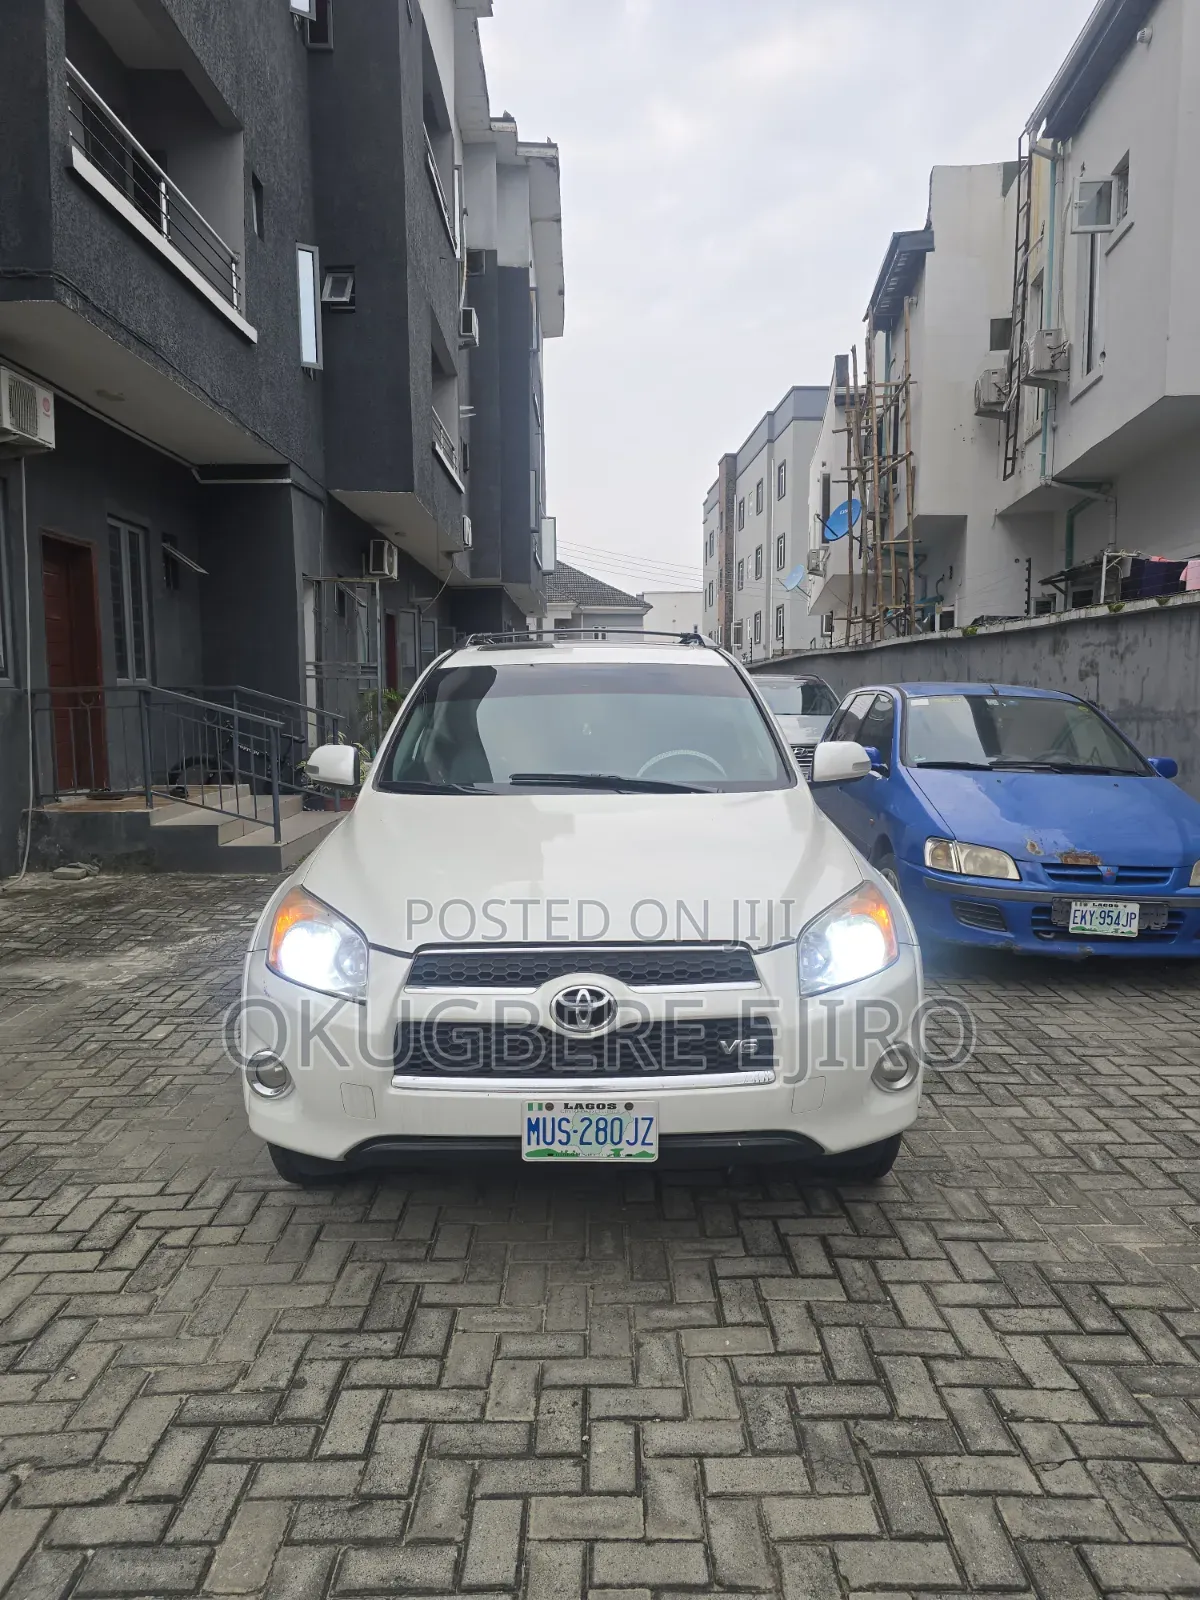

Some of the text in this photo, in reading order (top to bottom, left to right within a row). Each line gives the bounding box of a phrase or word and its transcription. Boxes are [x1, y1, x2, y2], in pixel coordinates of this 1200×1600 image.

[1072, 909, 1137, 928] EKY-954JP
[720, 1038, 758, 1055] V6
[563, 1102, 618, 1110] LAGOS
[526, 1116, 654, 1146] MUS-280JZ
